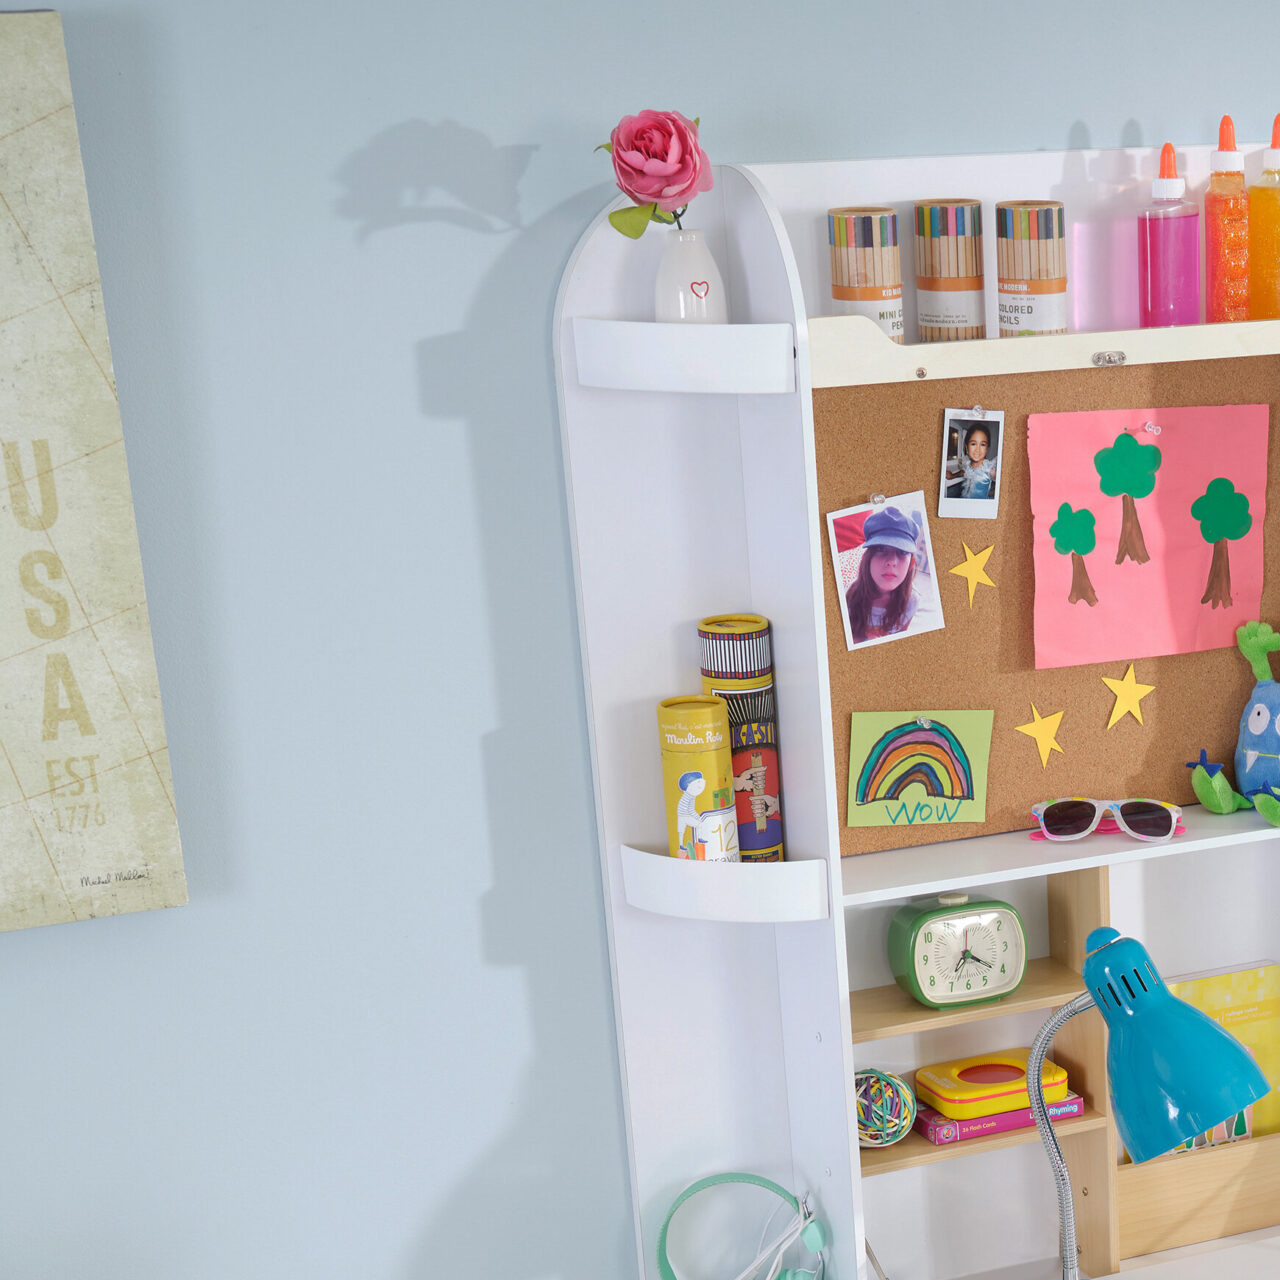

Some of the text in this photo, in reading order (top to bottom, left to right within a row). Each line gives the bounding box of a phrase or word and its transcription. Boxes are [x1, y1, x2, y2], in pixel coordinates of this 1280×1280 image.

[878, 310, 896, 320] MINI
[998, 314, 1020, 326] NCILS
[664, 732, 704, 745] Moulin
[46, 754, 100, 797] EST
[54, 802, 106, 832] 1776
[884, 799, 962, 825] WOW
[712, 820, 738, 852] 12
[996, 920, 1002, 932] 2
[924, 932, 933, 944] 10
[1002, 941, 1008, 952] 3
[922, 954, 929, 966] 9
[1000, 963, 1006, 974] 4
[930, 976, 936, 986] 8
[949, 982, 954, 992] 7
[966, 980, 972, 990] 6
[982, 976, 988, 986] 5
[1048, 1104, 1078, 1117] Rhyming
[982, 1121, 997, 1129] Cards
